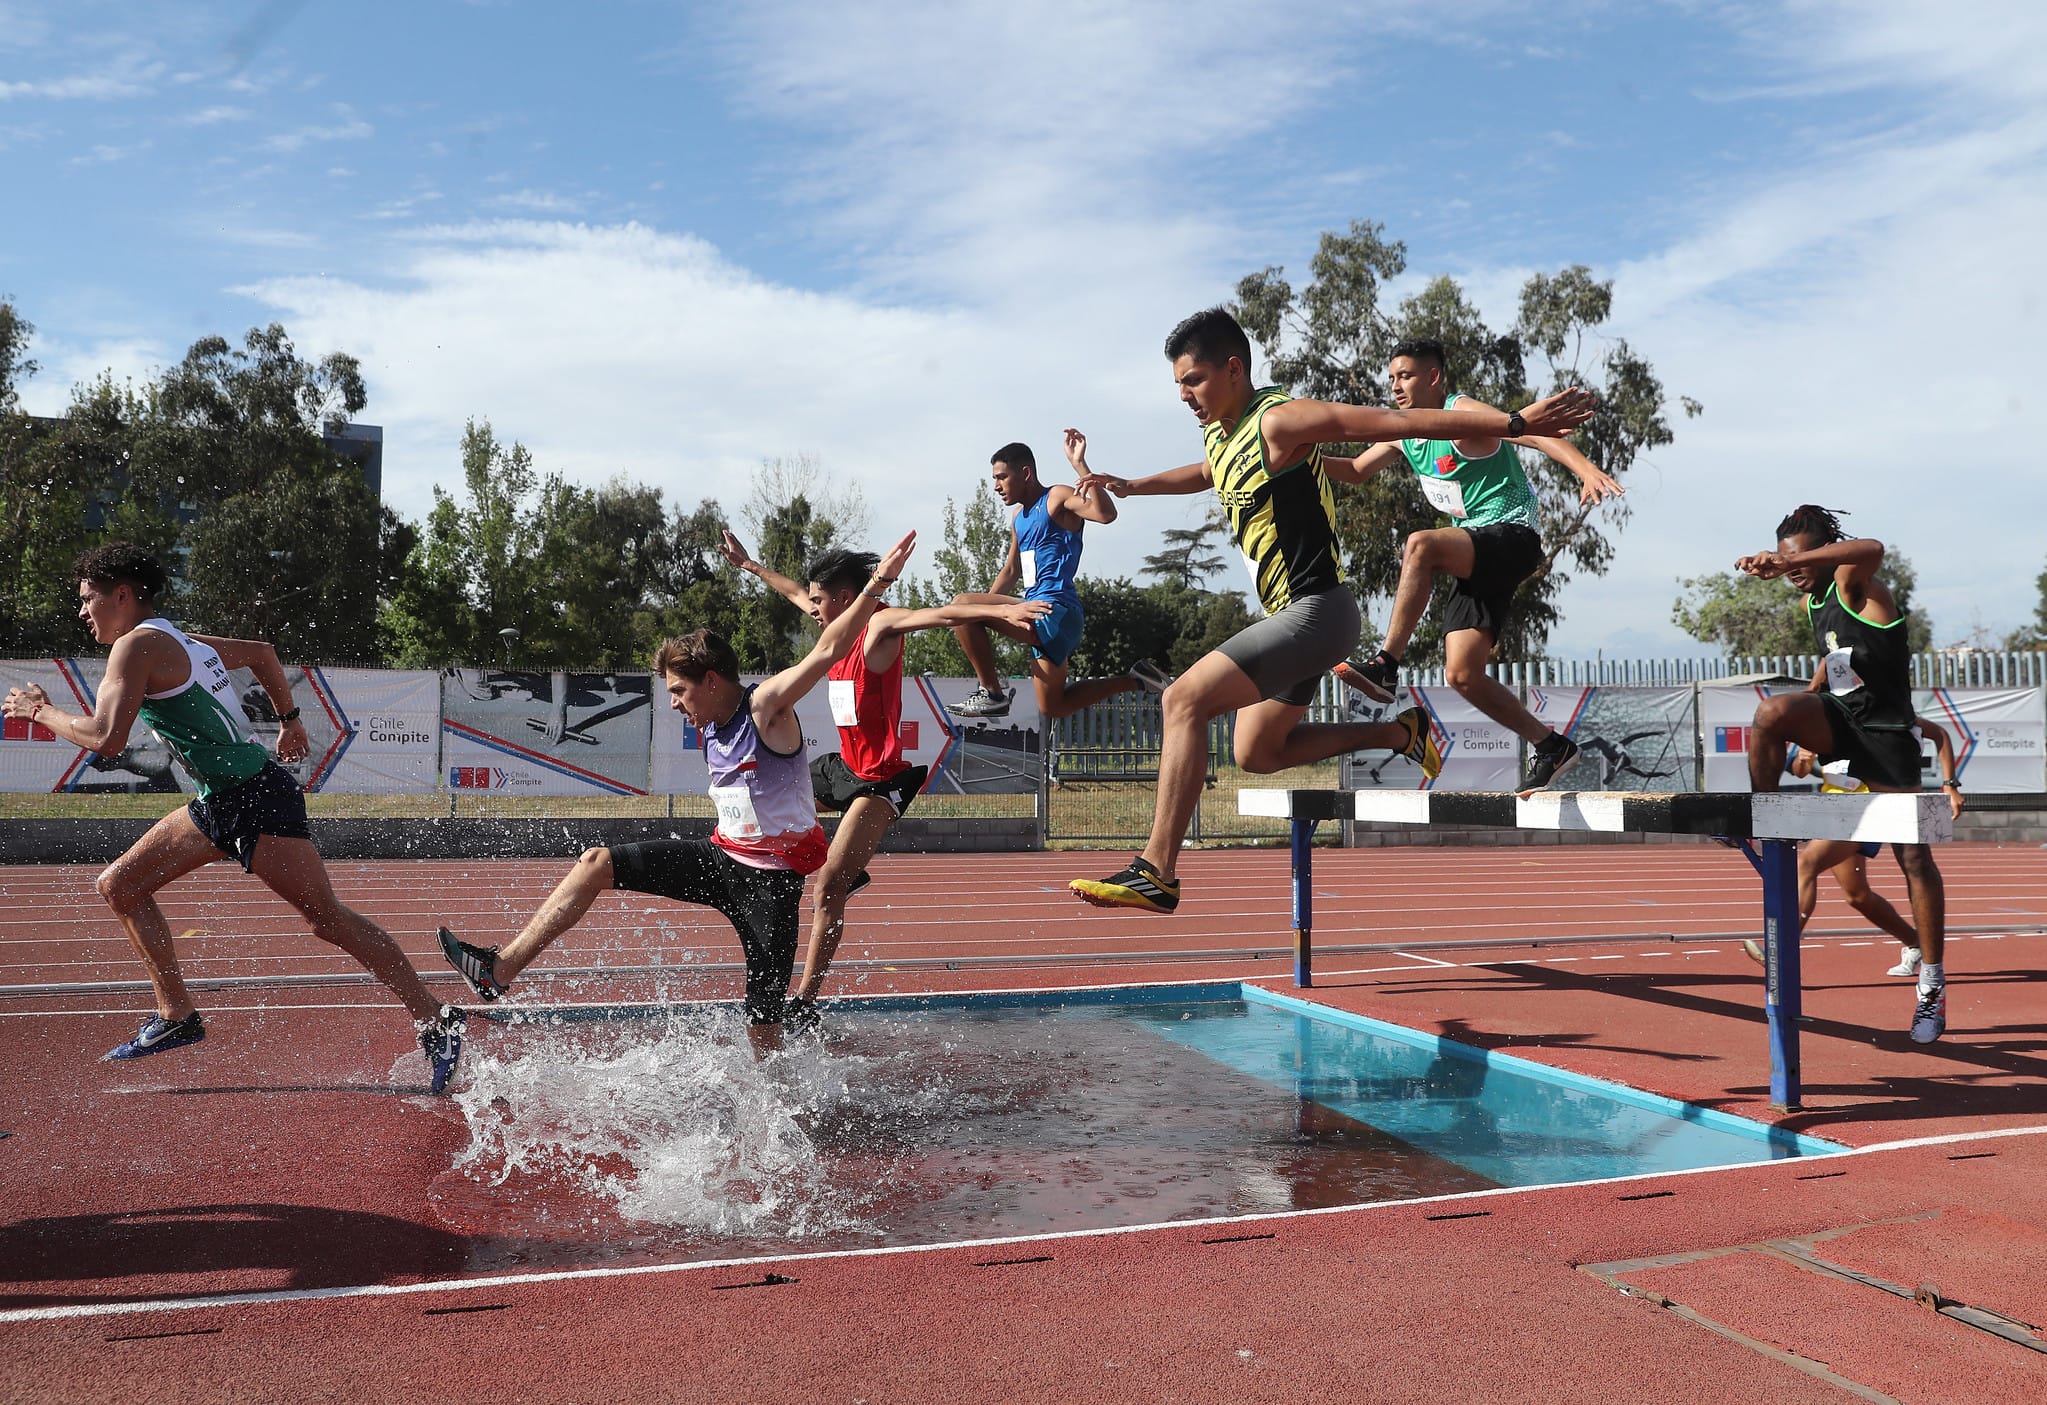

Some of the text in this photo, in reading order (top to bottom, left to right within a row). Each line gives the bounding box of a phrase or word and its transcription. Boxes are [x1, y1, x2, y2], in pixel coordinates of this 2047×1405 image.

[369, 717, 404, 729] Chile
[369, 730, 430, 744] Compite
[1463, 728, 1490, 738] Chile
[1986, 727, 2015, 737] Chile
[1463, 740, 1510, 751] Compite
[1987, 739, 2035, 750] Compite
